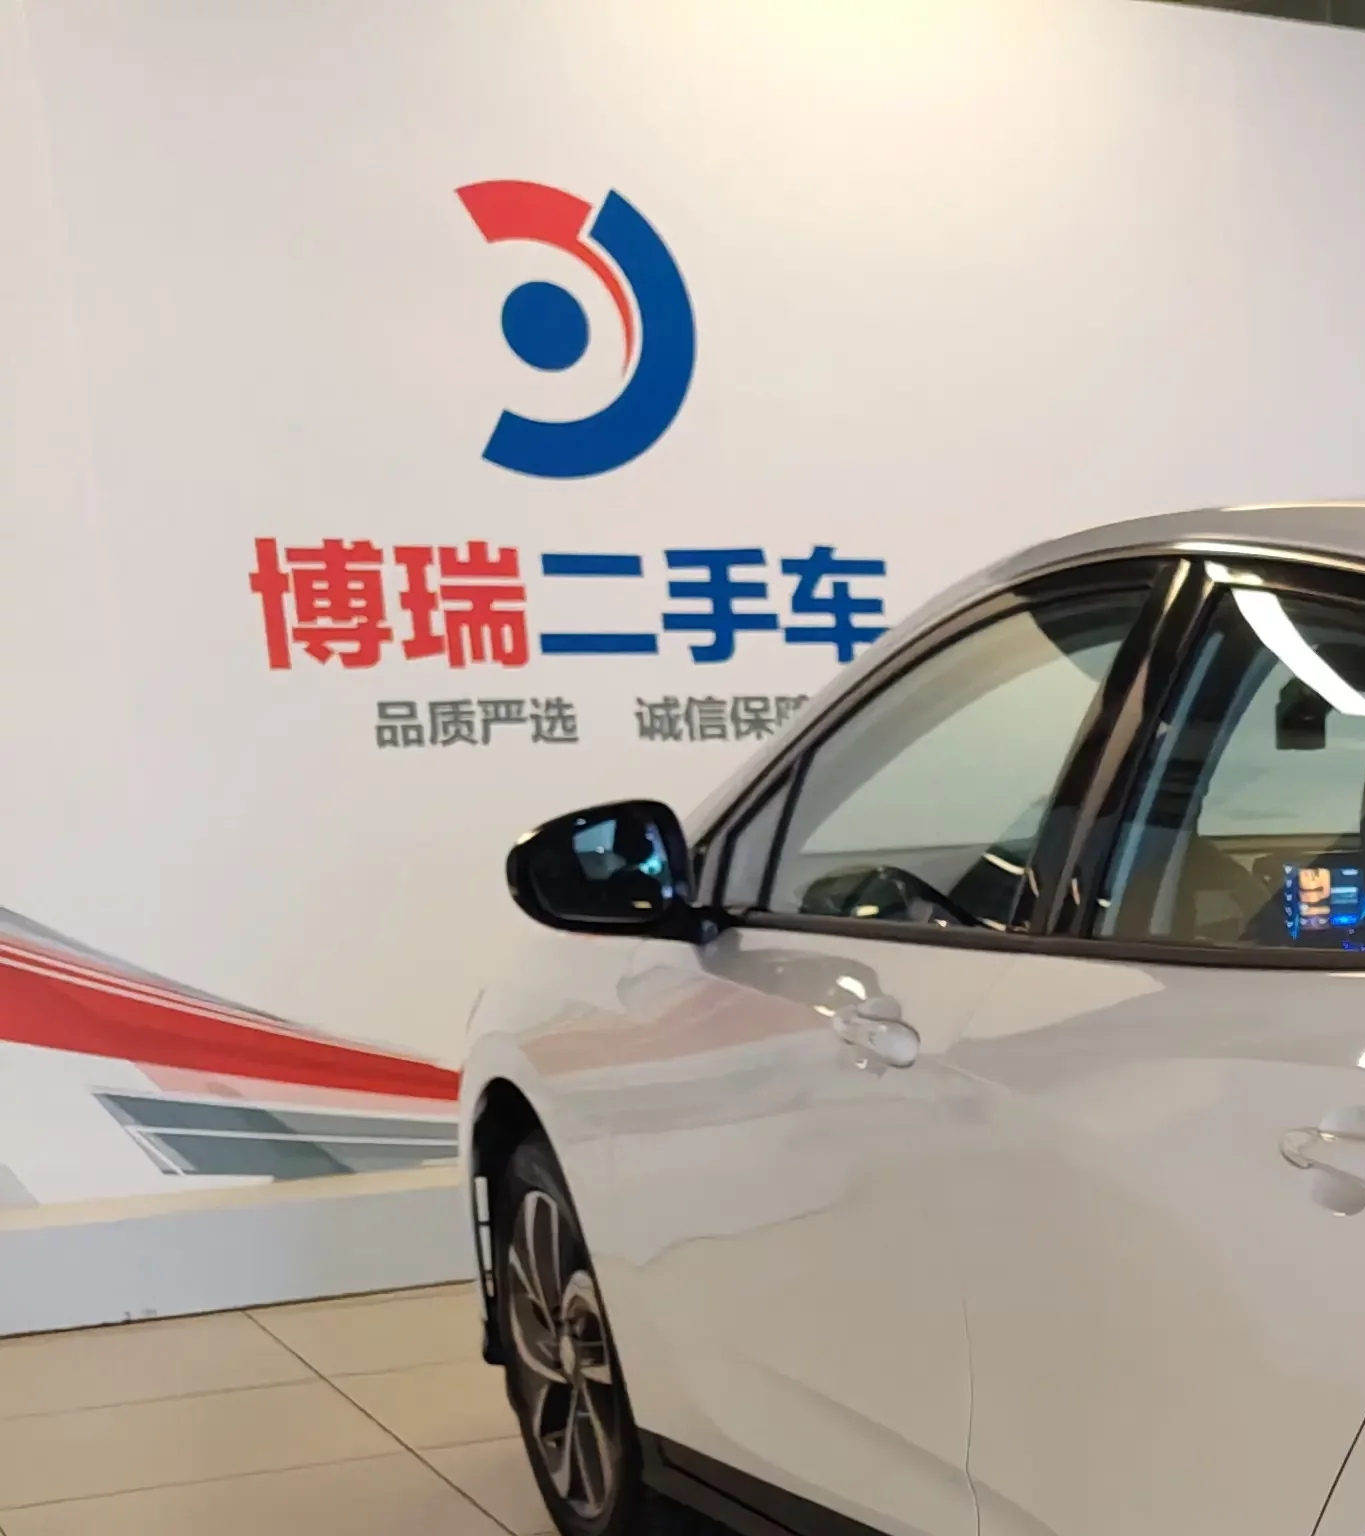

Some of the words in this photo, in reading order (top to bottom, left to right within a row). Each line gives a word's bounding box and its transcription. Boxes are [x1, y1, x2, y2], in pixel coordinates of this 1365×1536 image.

[248, 536, 892, 671] 博瑞二手车
[375, 697, 579, 748] 品质严选
